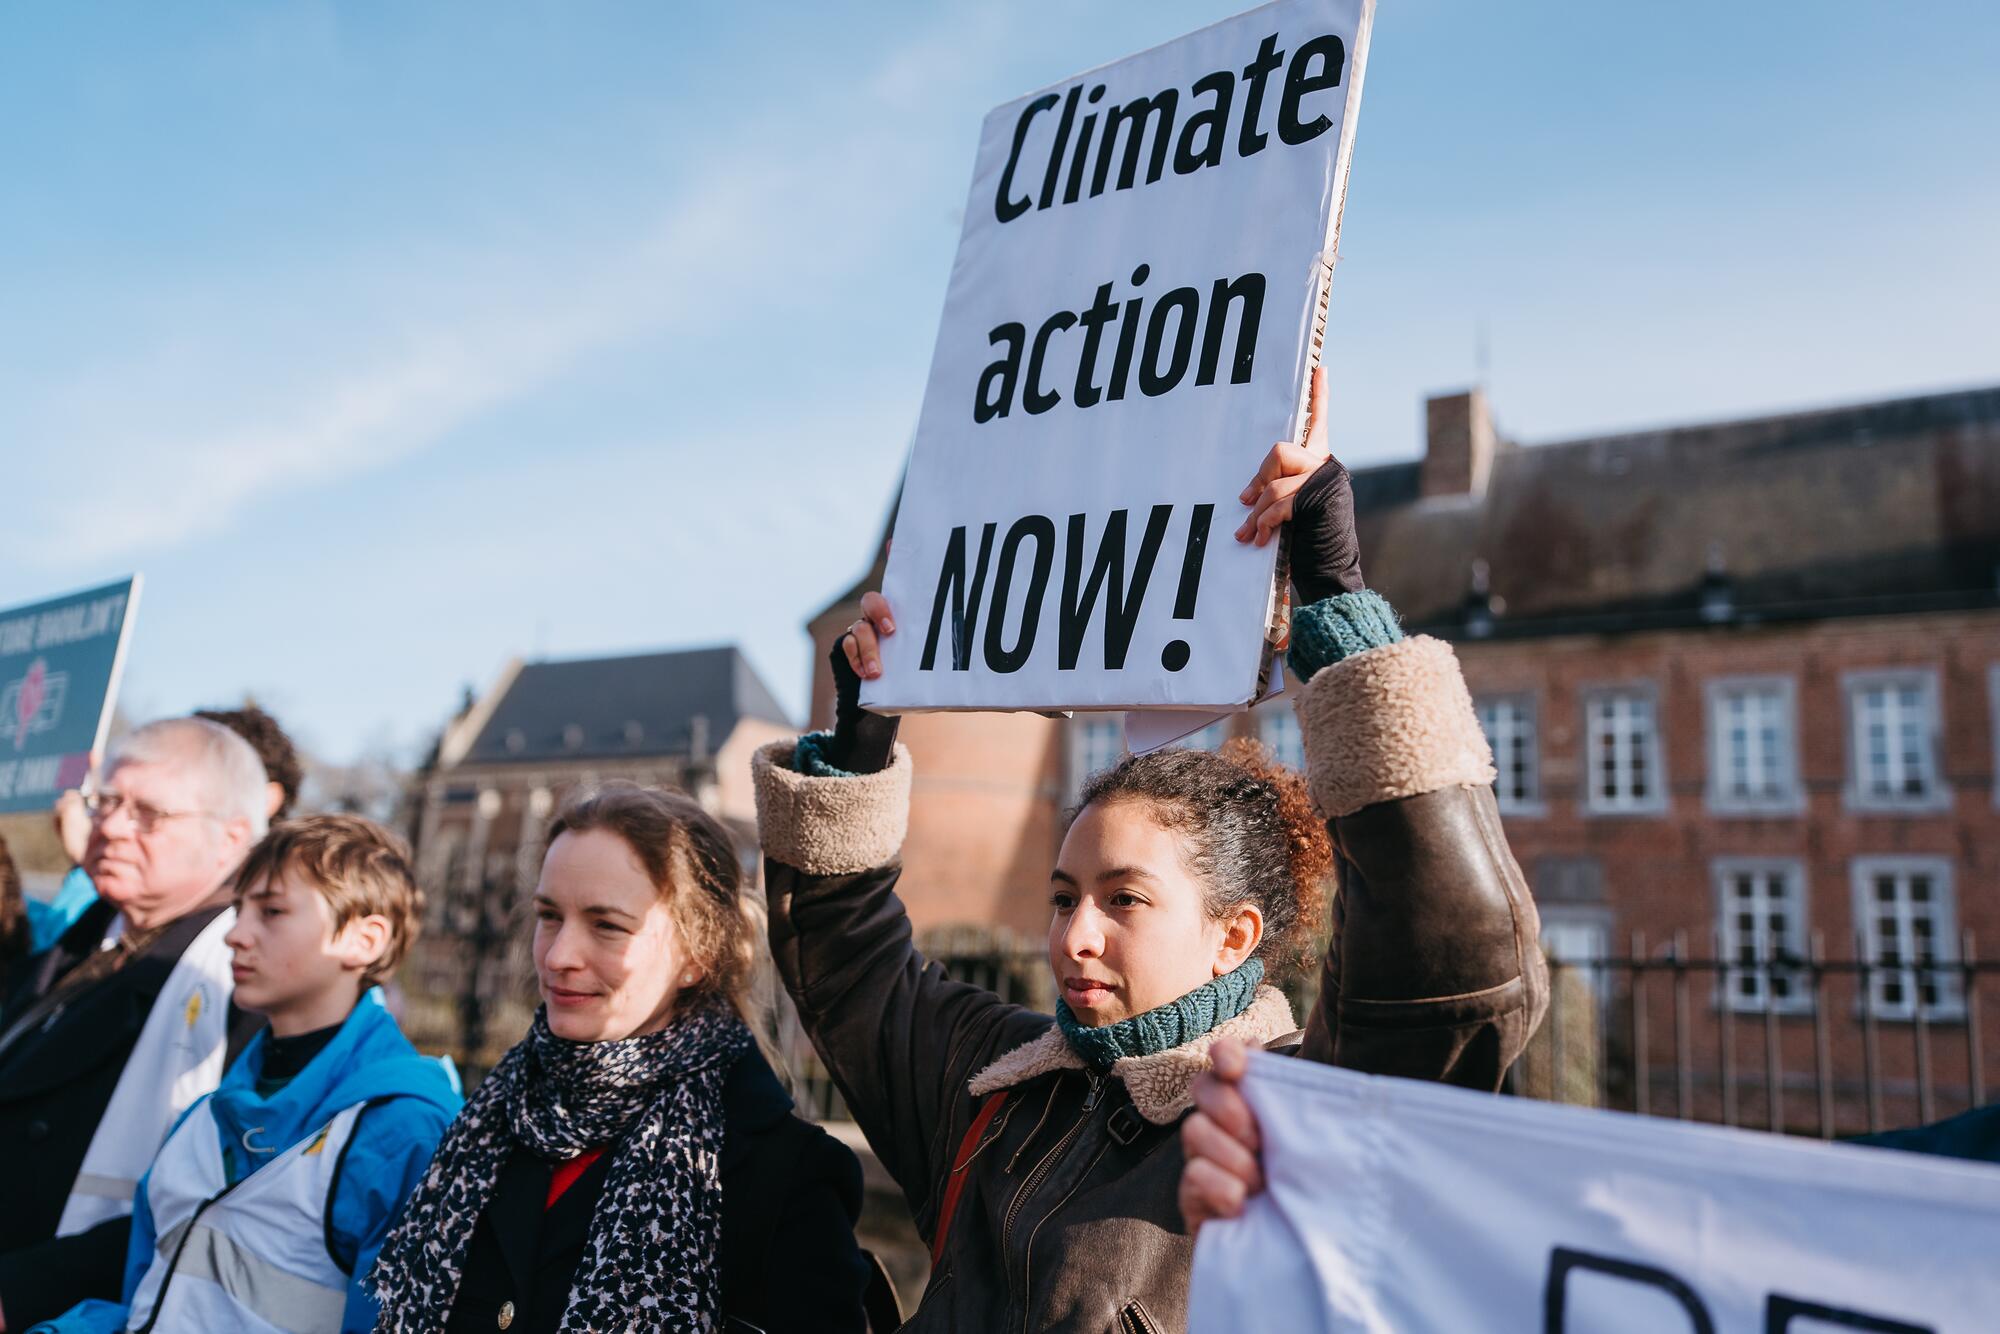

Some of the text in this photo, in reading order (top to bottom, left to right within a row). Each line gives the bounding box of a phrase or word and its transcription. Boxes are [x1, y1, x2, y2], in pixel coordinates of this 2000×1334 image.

[994, 32, 1346, 224] Climate
[973, 263, 1267, 424] action
[918, 502, 1216, 674] NOW!
